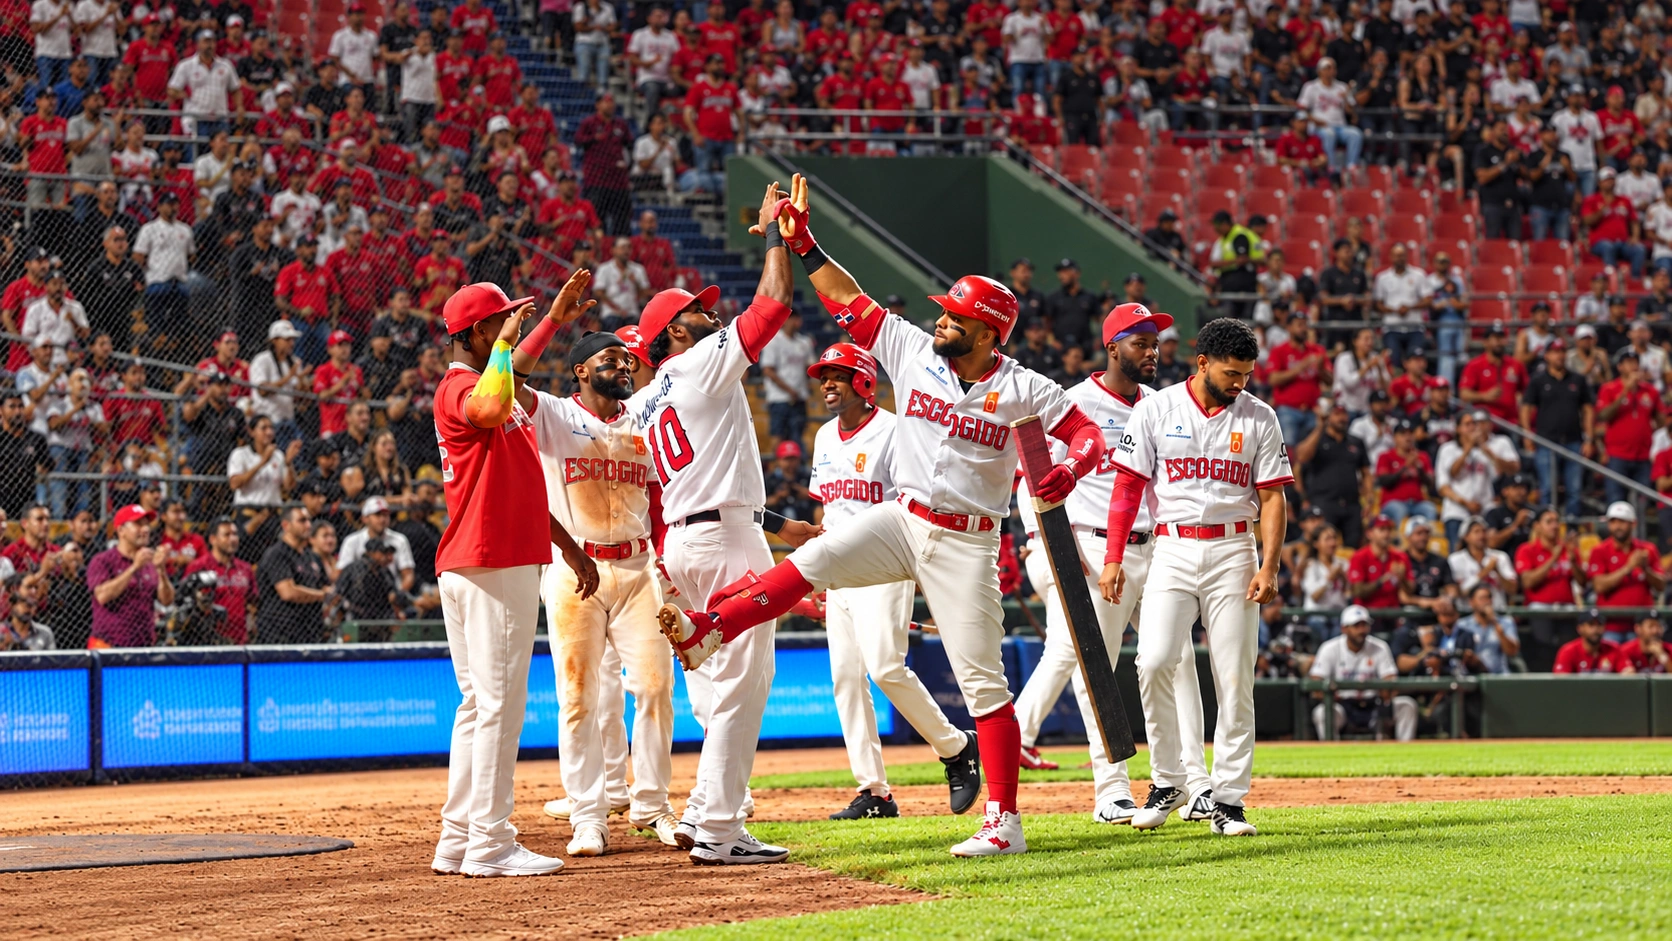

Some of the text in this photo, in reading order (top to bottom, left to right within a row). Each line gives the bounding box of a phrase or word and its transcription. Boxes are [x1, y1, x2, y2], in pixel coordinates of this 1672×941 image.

[649, 405, 694, 487] 10
[905, 389, 1010, 451] ESCOGIDO
[1164, 457, 1251, 488] ESCOGIDO
